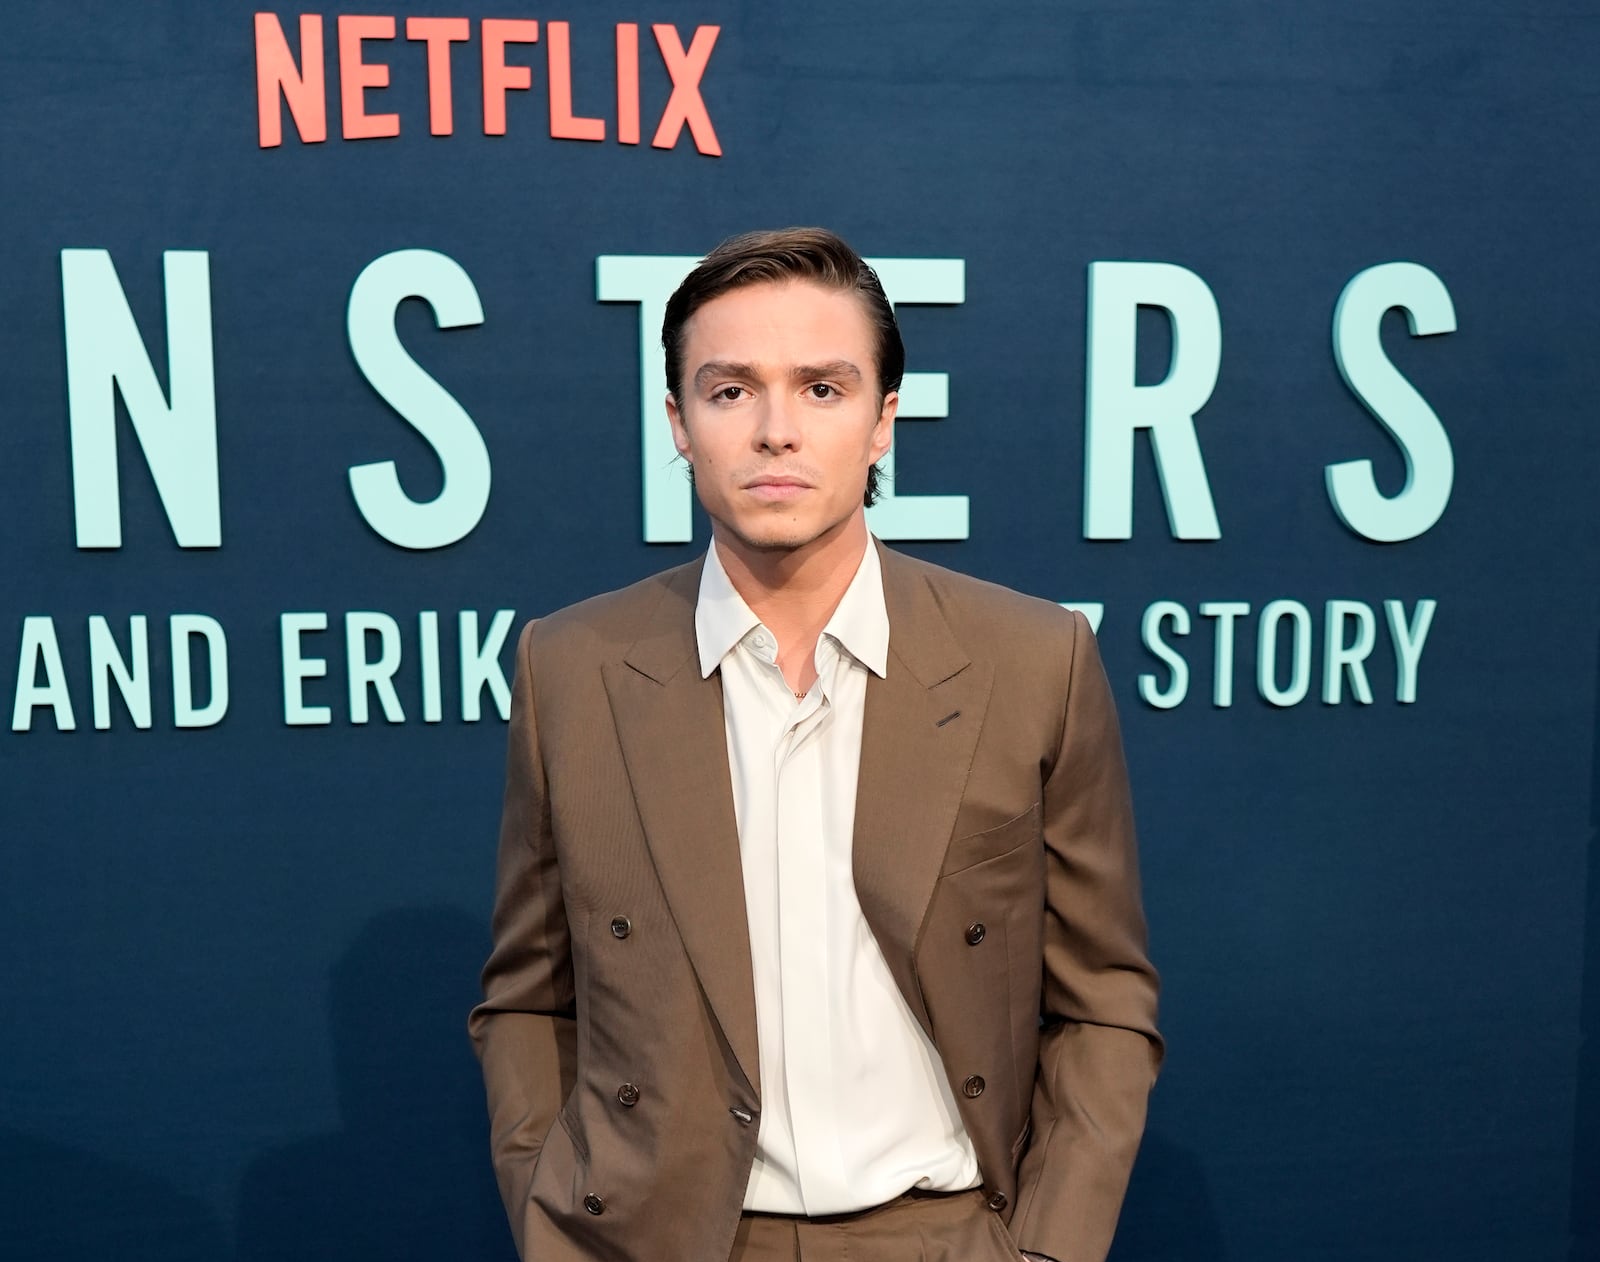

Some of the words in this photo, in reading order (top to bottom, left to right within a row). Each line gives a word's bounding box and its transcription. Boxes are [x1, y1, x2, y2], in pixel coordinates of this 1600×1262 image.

[254, 12, 722, 157] NETFLIX
[12, 615, 229, 731] AND
[281, 610, 516, 726] ERIK
[1138, 600, 1438, 709] STORY
